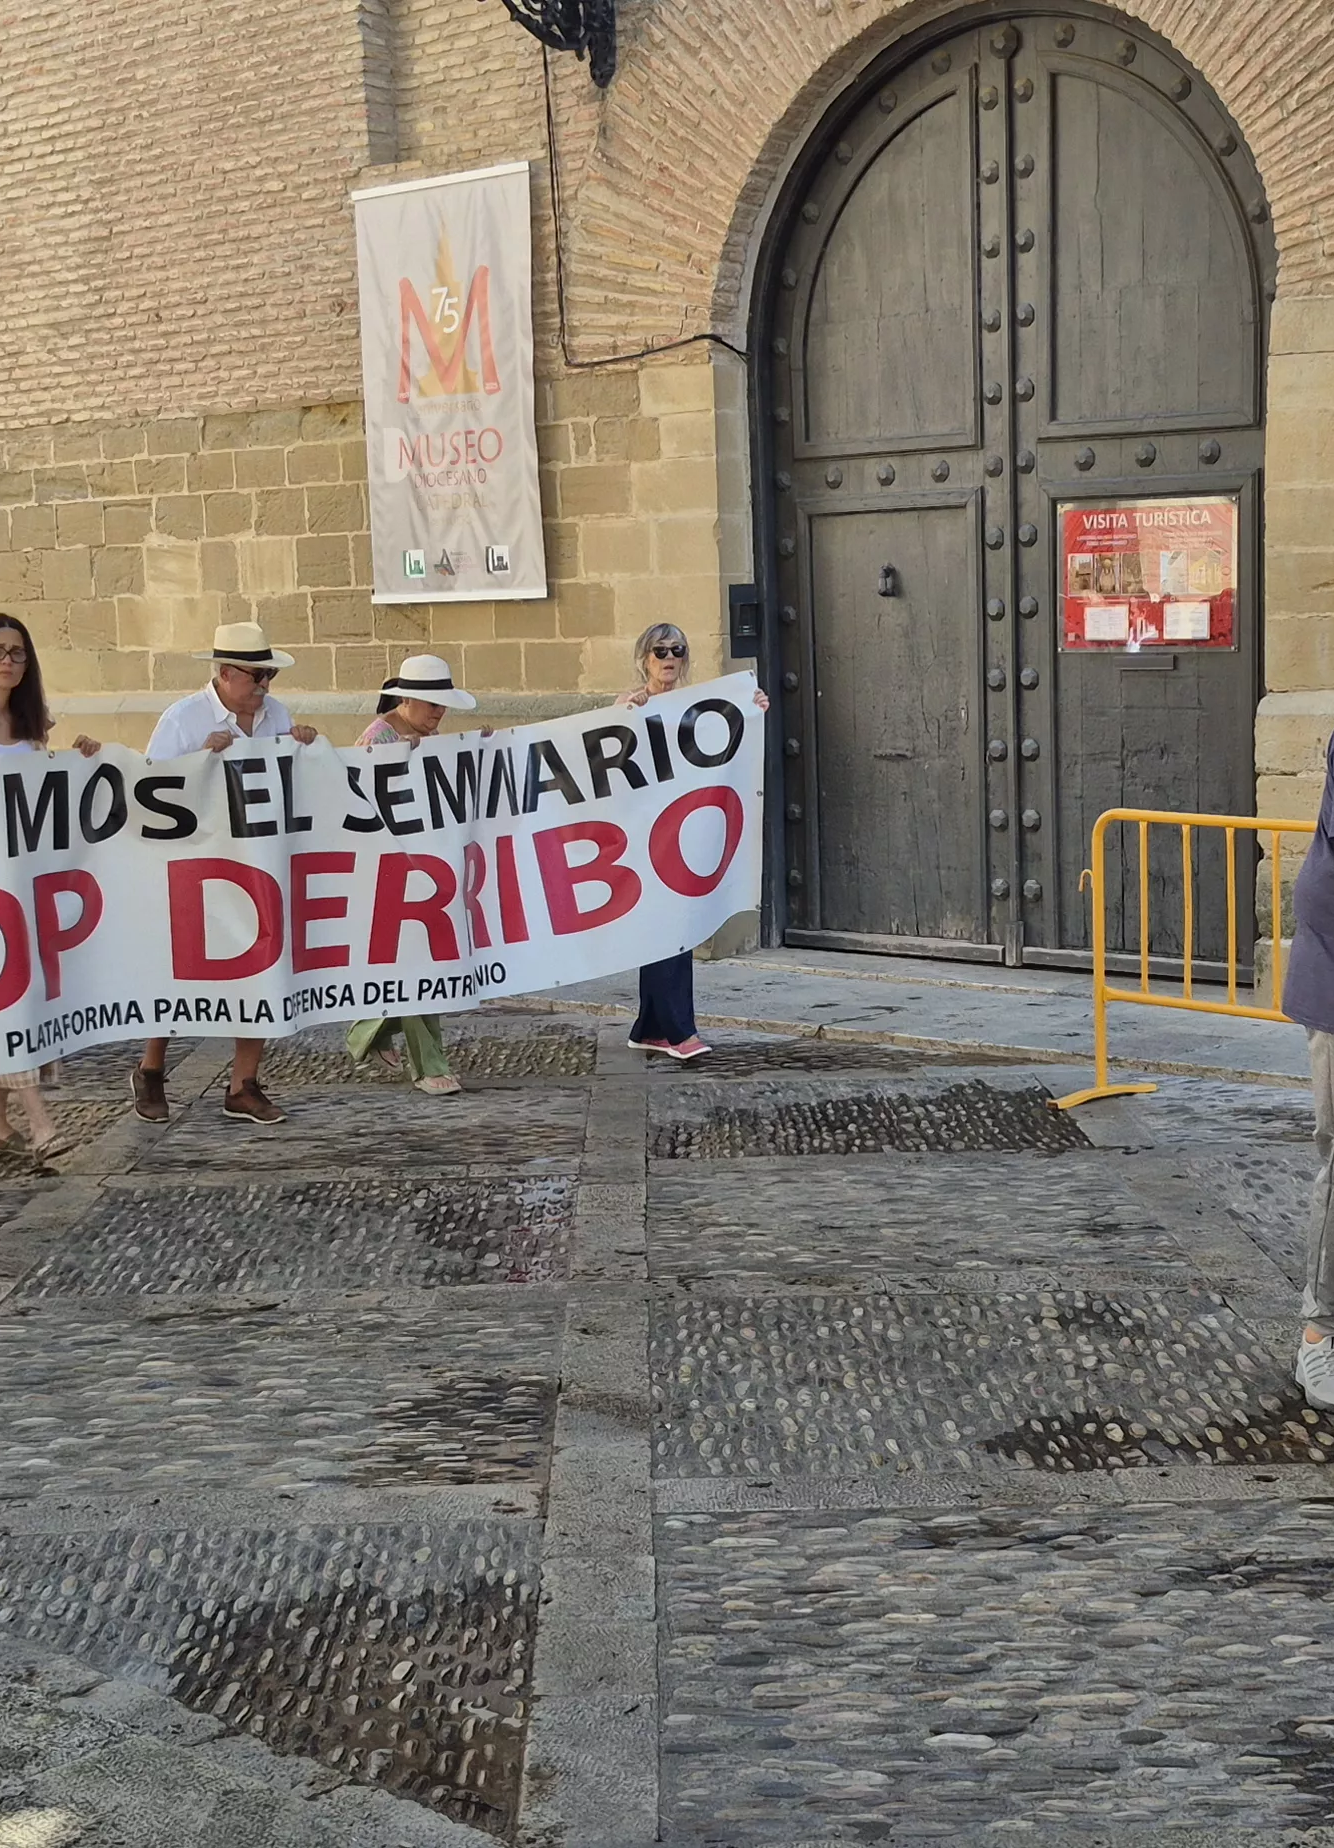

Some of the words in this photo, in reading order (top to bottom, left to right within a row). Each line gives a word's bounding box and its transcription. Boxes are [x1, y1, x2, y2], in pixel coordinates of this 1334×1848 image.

[431, 286, 459, 334] 75
[398, 427, 503, 469] MUSEO
[414, 468, 487, 489] DIOCESANO
[416, 491, 489, 511] CATEDRAL
[1082, 513, 1129, 530] VISITA
[1133, 506, 1212, 528] TURÍSTICA
[223, 755, 312, 839] EL
[342, 697, 745, 837] SEMINARIO
[166, 784, 745, 982] DERRIBO
[5, 996, 145, 1058] PLATAFORMA
[154, 997, 234, 1023] PARA
[239, 997, 275, 1023] LA
[282, 983, 356, 1022] DEFENSA
[363, 979, 410, 1006] DEL
